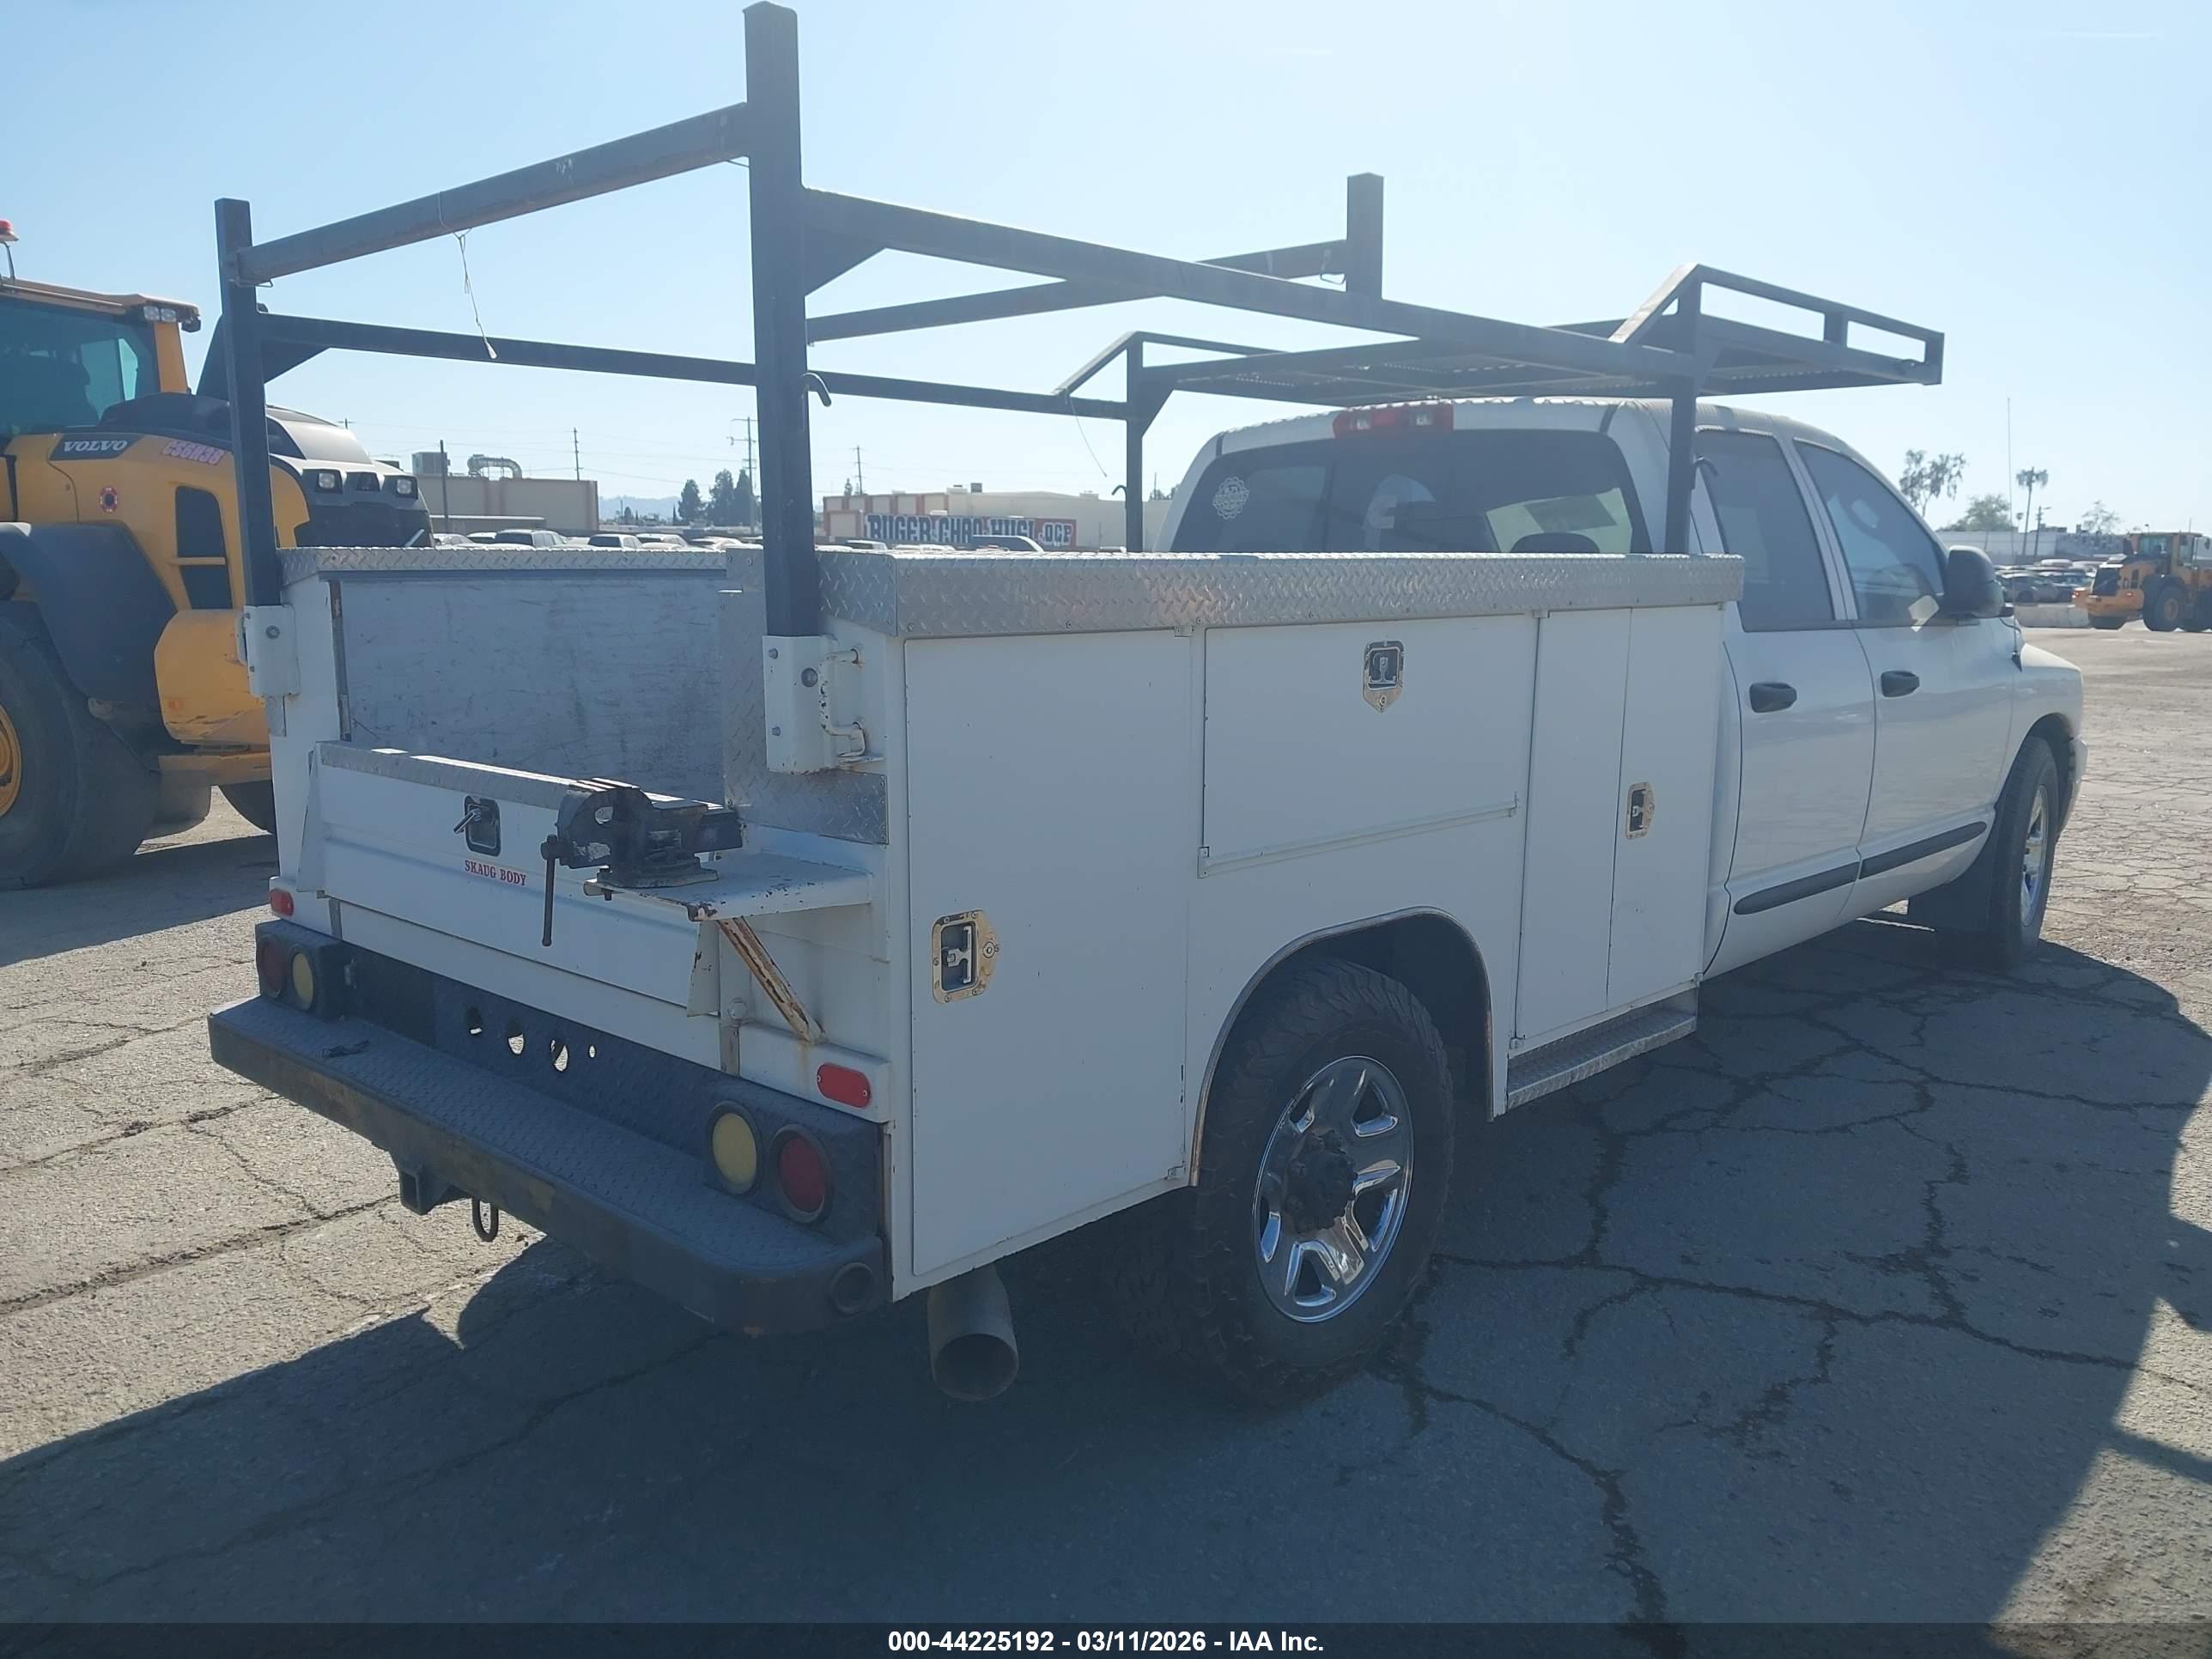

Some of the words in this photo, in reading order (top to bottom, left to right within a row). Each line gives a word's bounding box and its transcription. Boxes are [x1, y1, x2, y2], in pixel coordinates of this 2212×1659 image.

[64, 441, 128, 452] VOLVO
[465, 860, 496, 878] SKAUG
[500, 869, 526, 886] BODY
